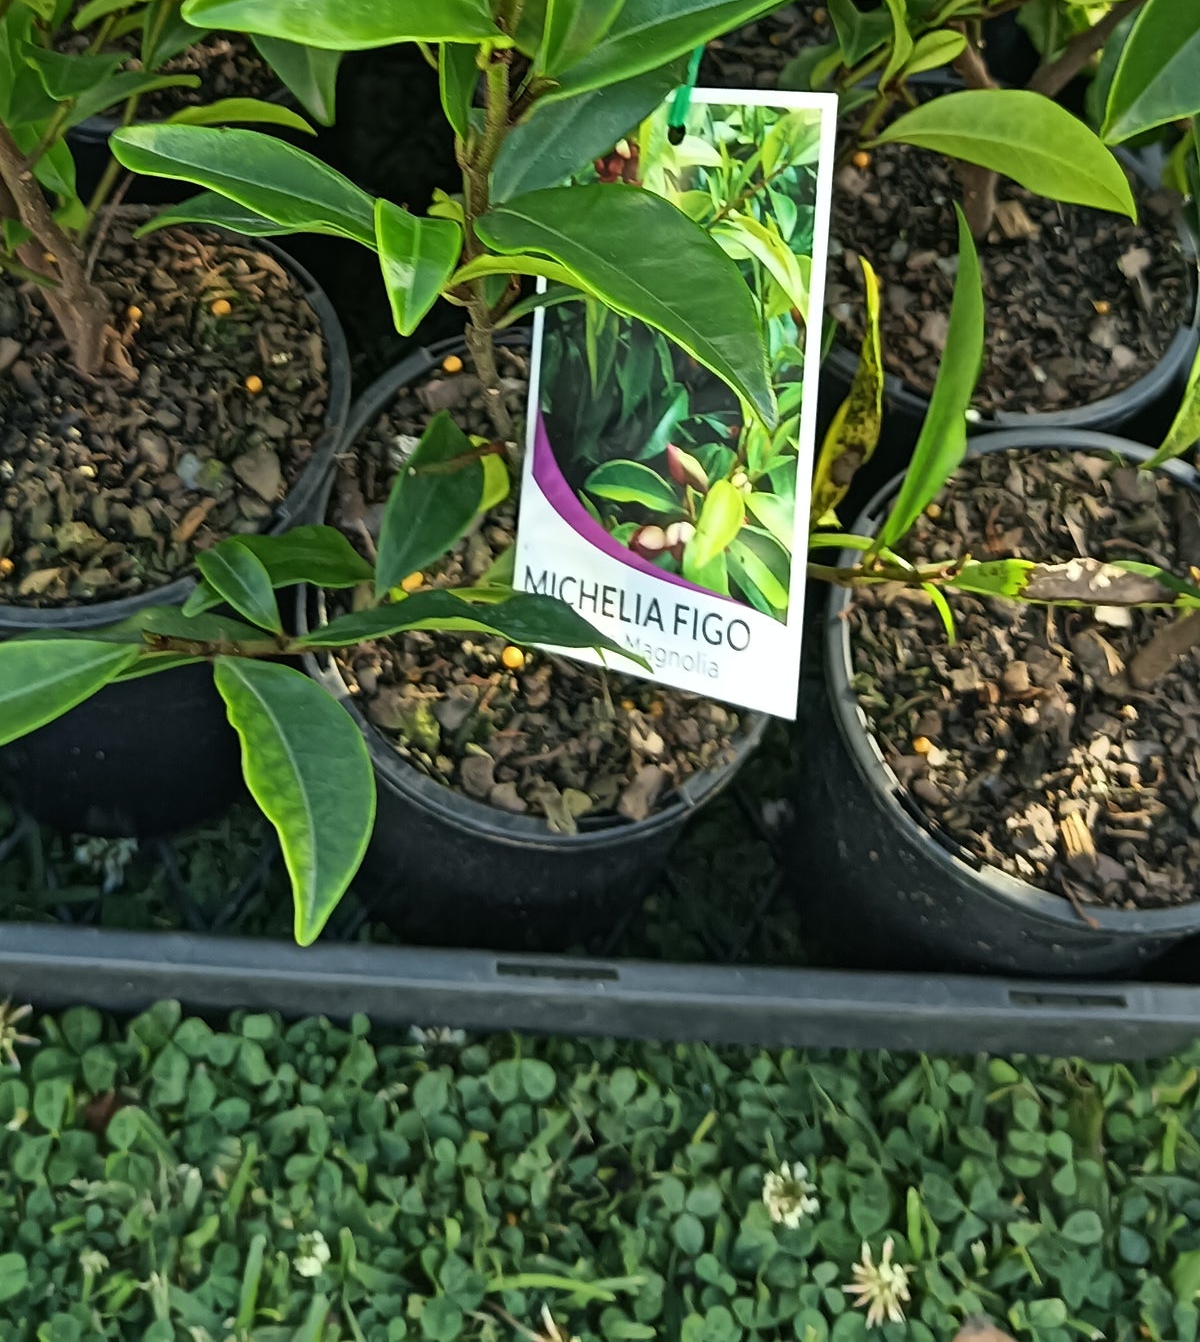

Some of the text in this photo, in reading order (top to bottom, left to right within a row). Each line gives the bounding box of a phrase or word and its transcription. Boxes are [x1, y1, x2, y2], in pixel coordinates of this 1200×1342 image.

[525, 565, 750, 651] MICHELIA FIGO
[625, 634, 719, 678] Magnolia
